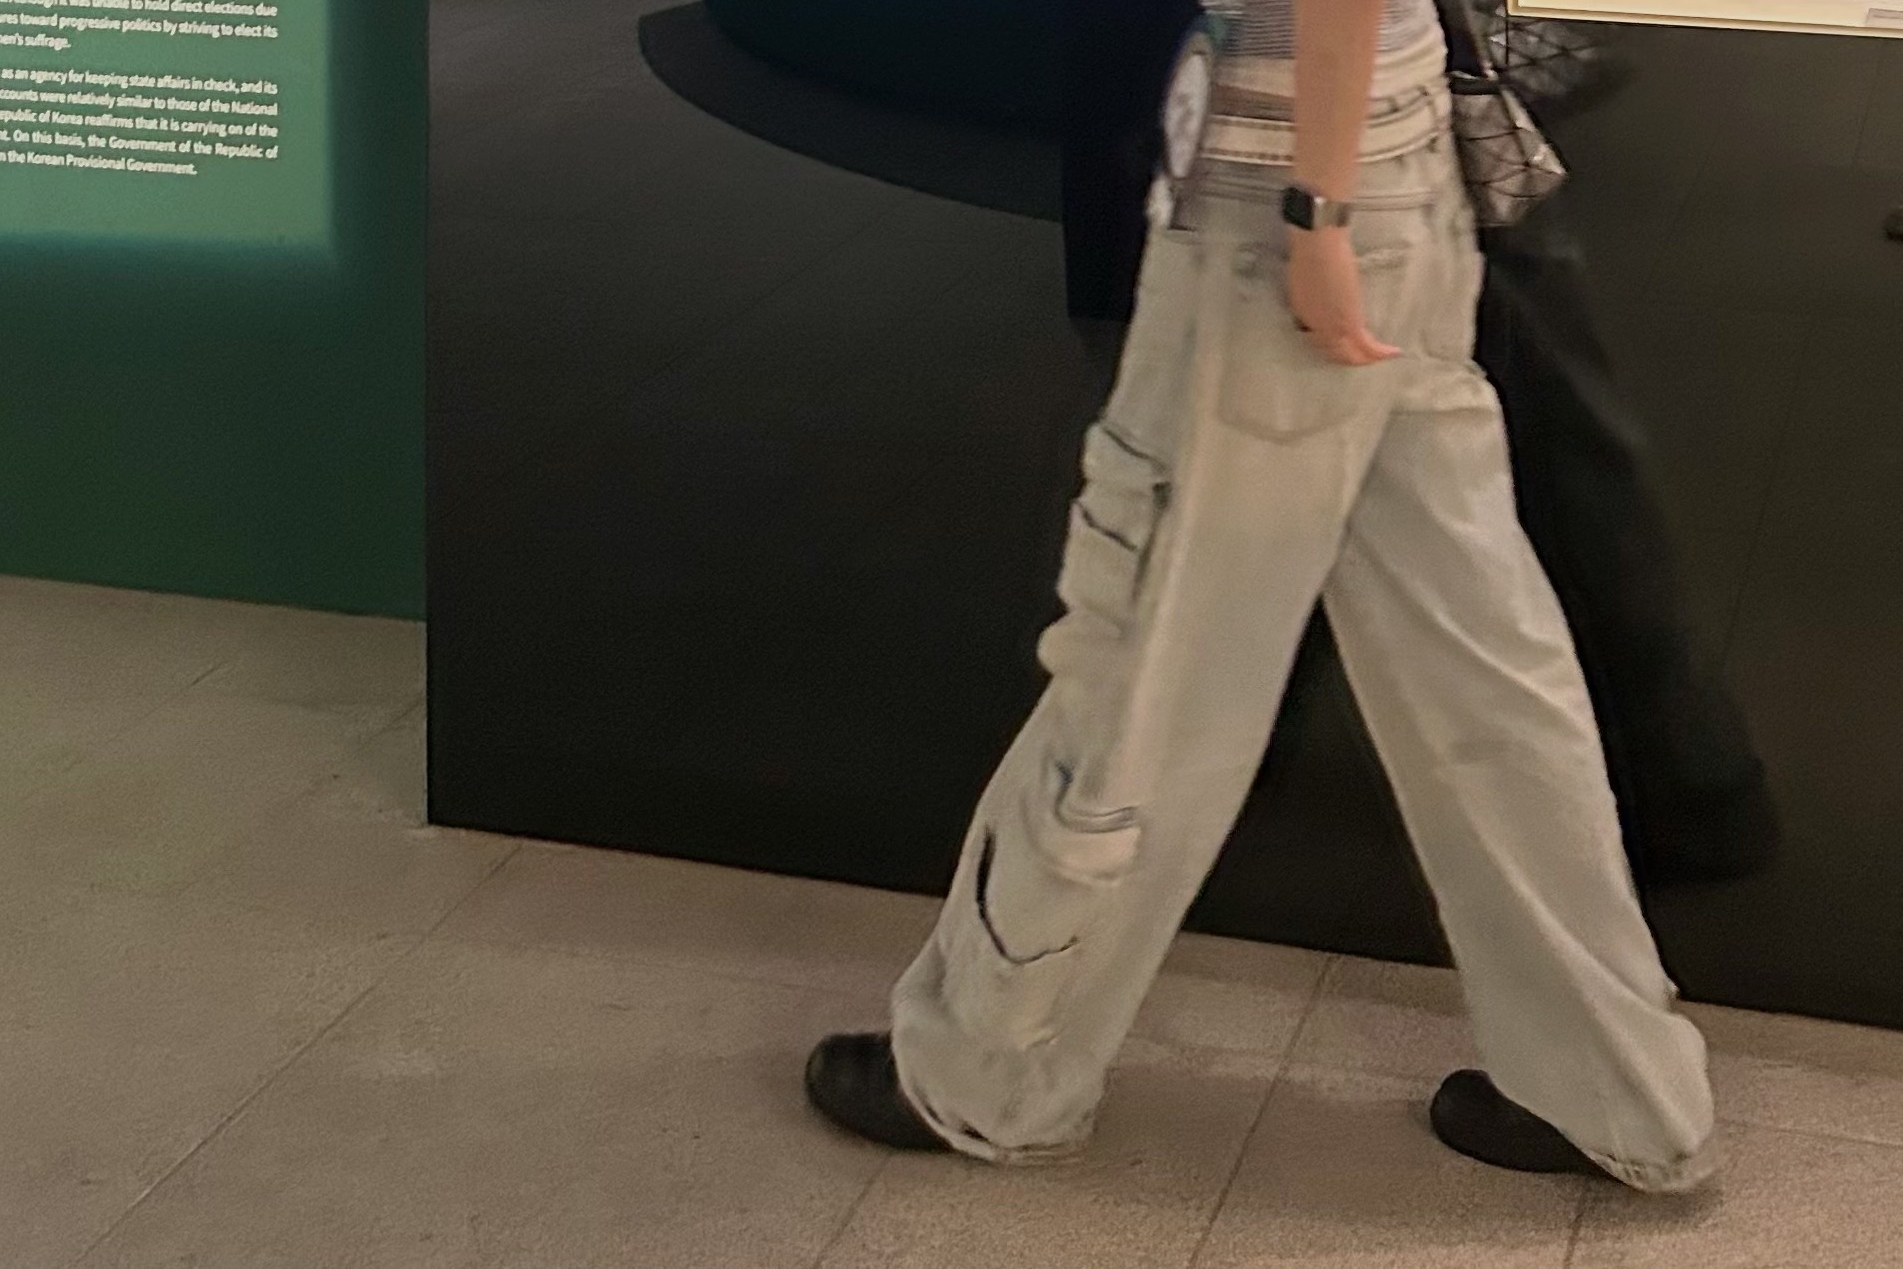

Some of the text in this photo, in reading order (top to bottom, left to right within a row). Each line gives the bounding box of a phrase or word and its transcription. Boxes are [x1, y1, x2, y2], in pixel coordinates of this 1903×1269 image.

[204, 0, 254, 16] elections
[255, 2, 277, 17] due
[20, 12, 262, 39] toward progressive politics striving elect
[24, 33, 71, 52] suffrage.
[30, 68, 262, 95] agency for keeping state affairs check, and
[40, 92, 66, 104] were
[67, 91, 115, 109] relatively
[167, 96, 197, 112] those
[212, 99, 230, 114] the
[232, 100, 277, 116] National
[52, 111, 278, 138] Korea reaffirms that carrying on the
[13, 128, 263, 159] On this basis, the Government the Republic
[8, 150, 25, 164] the
[27, 151, 64, 166] Korean
[66, 153, 125, 170] Provisional
[127, 157, 197, 176] Government.
